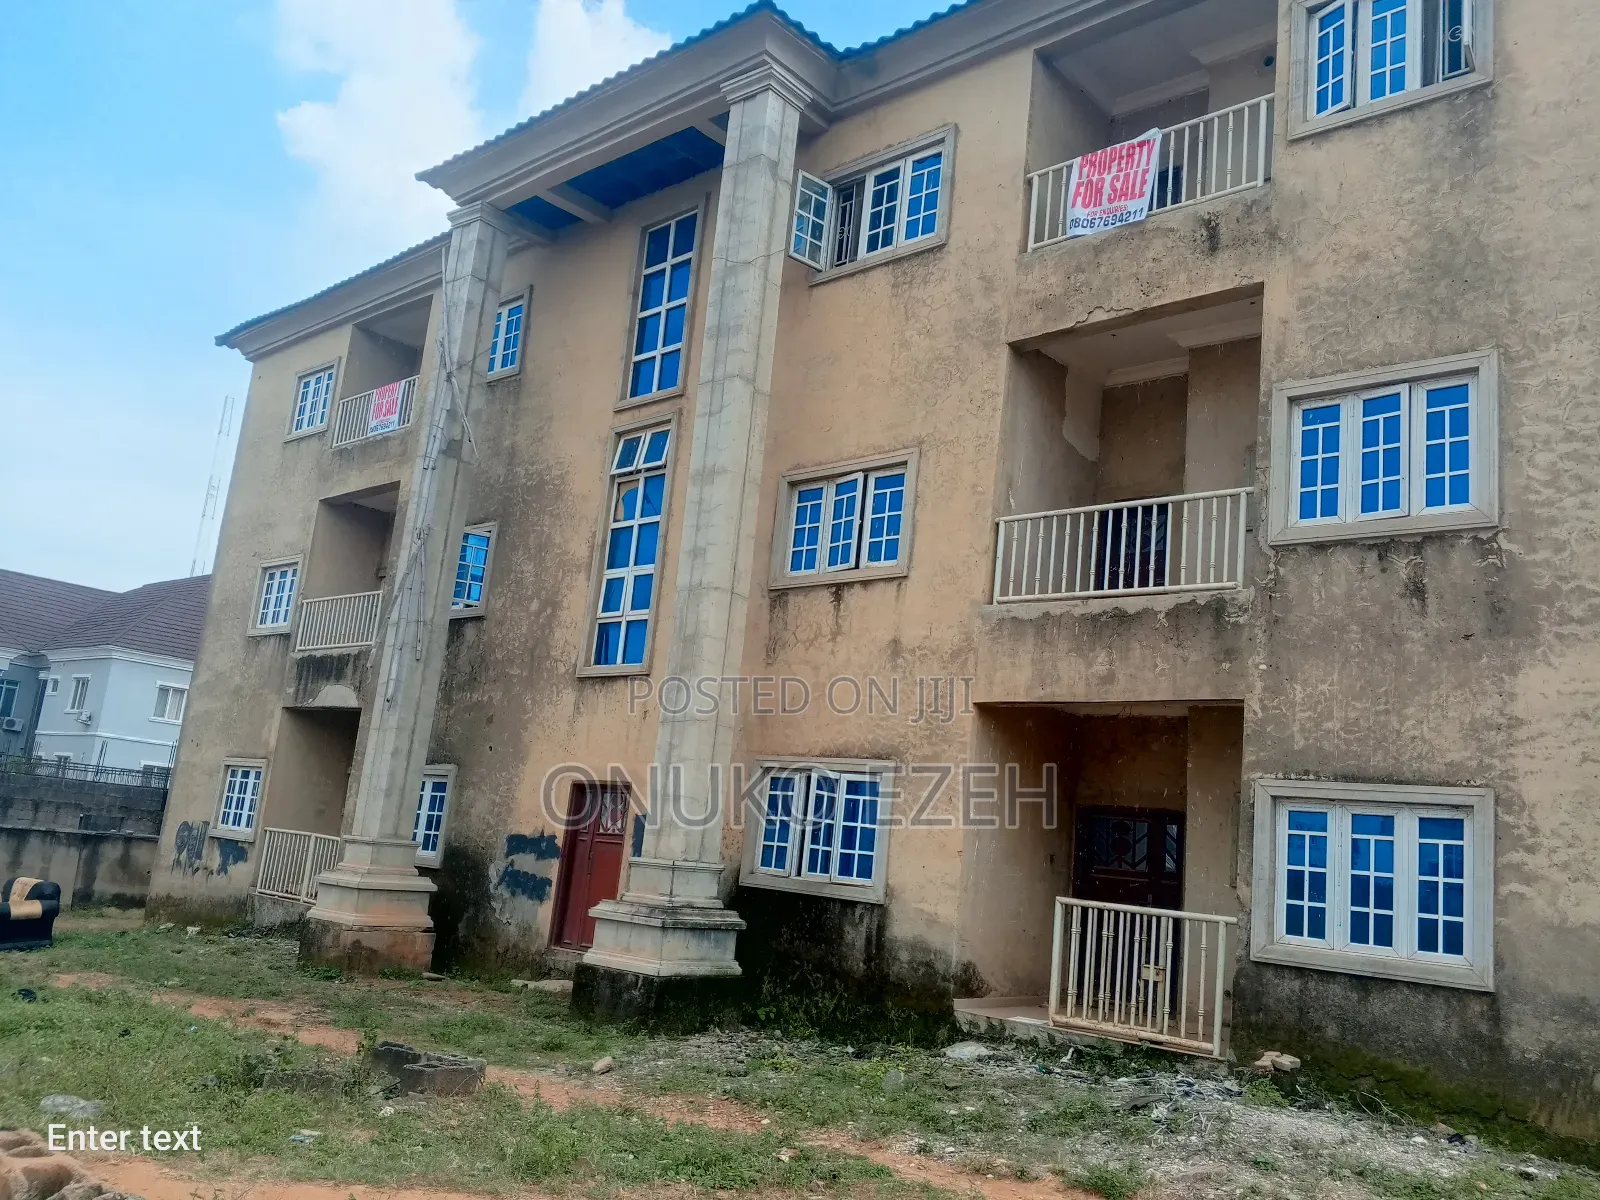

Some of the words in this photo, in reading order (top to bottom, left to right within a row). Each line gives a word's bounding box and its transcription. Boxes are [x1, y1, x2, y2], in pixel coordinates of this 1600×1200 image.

[1078, 138, 1156, 180] PROPERTY
[1071, 176, 1105, 209] FOR
[1107, 167, 1150, 205] SALE
